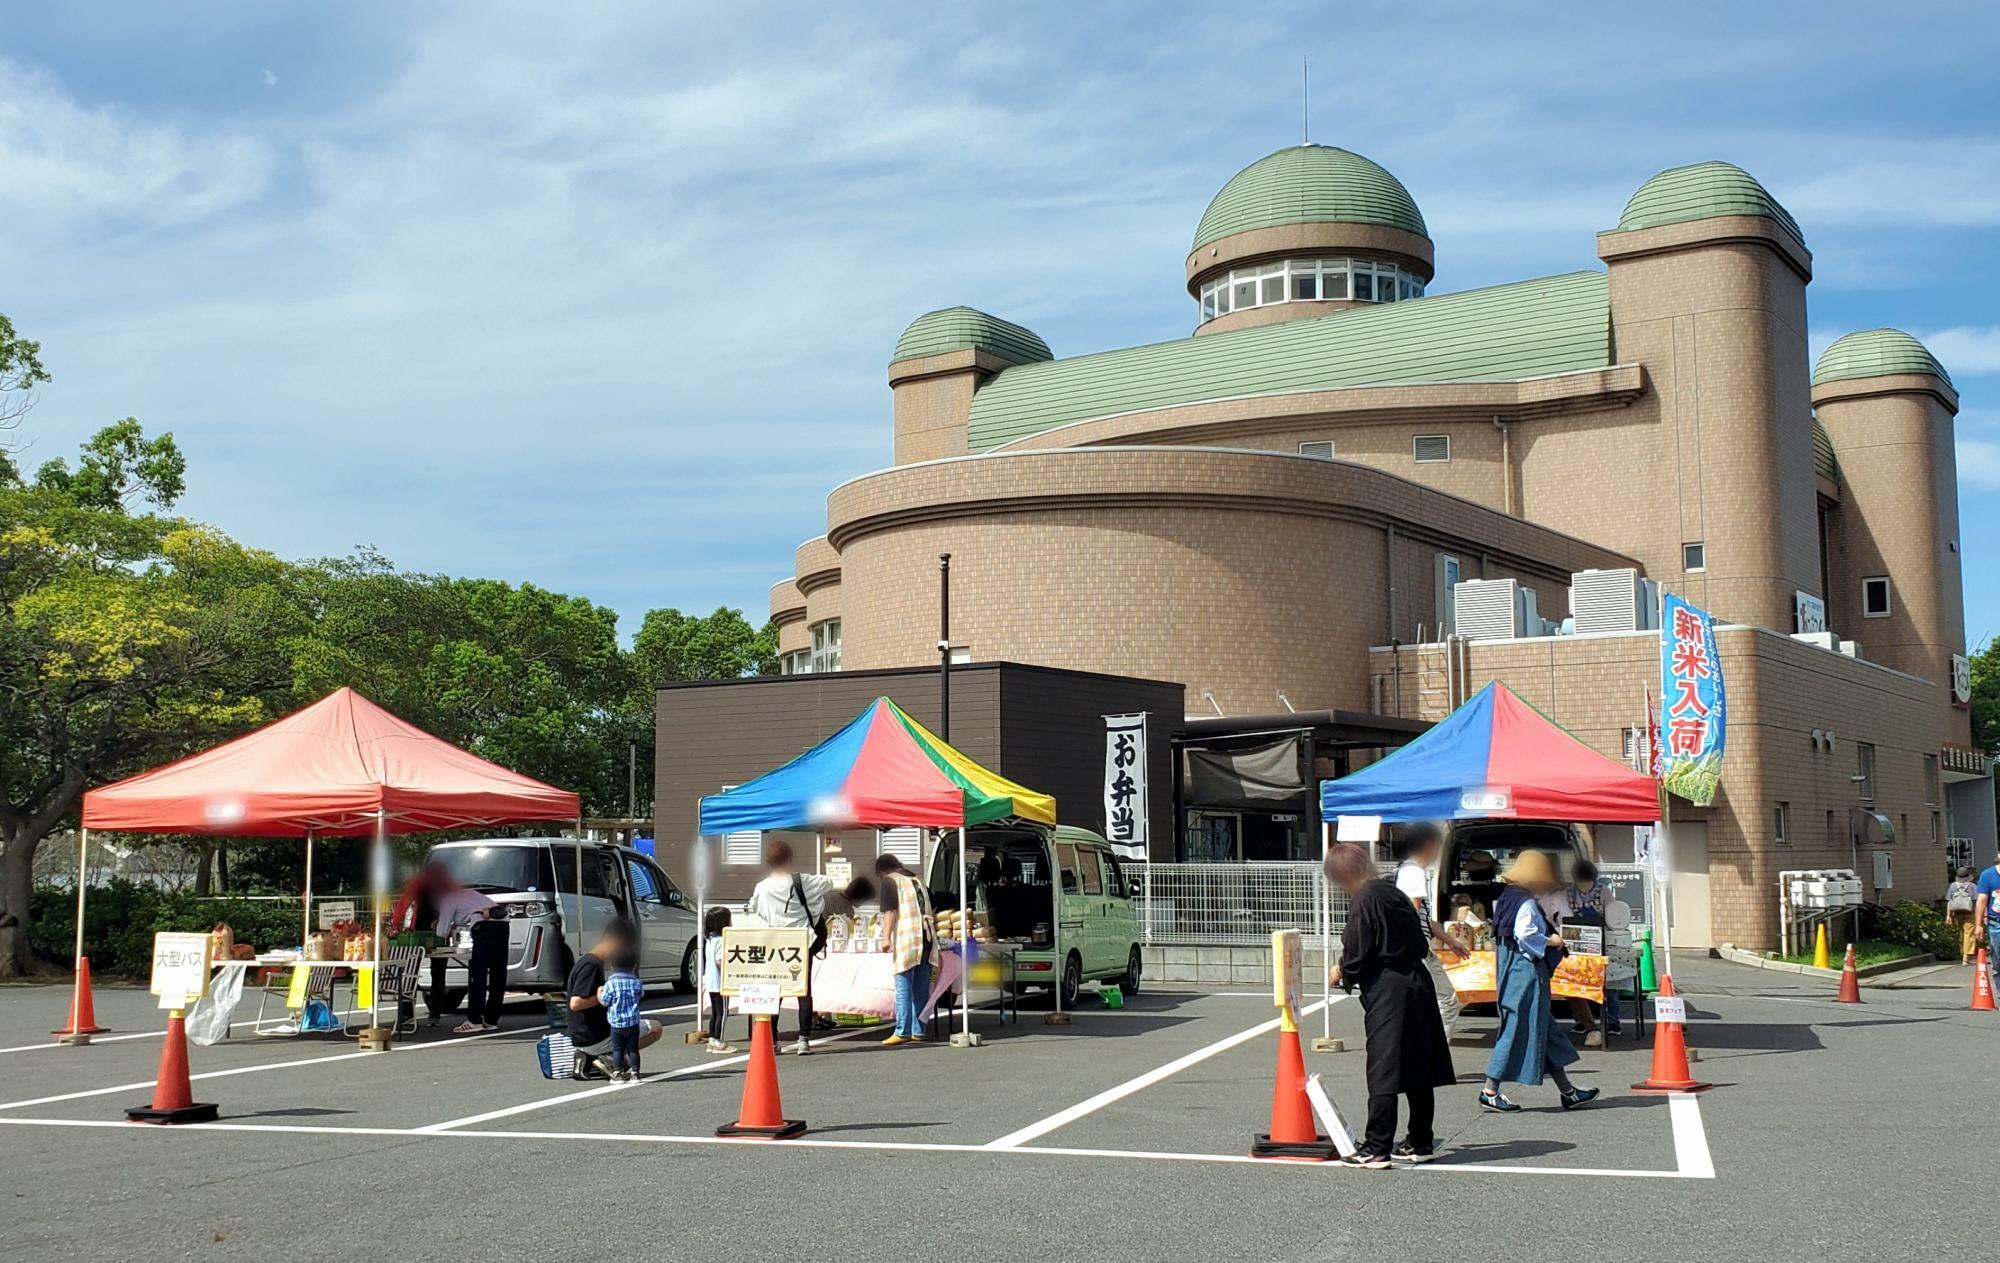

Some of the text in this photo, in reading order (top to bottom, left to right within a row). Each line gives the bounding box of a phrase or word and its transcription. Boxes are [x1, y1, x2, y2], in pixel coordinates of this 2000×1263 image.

[1668, 607, 1709, 757] 新米入荷
[1110, 733, 1137, 840] お弁当
[156, 950, 203, 968] 大型バス
[727, 944, 803, 964] 大型バス
